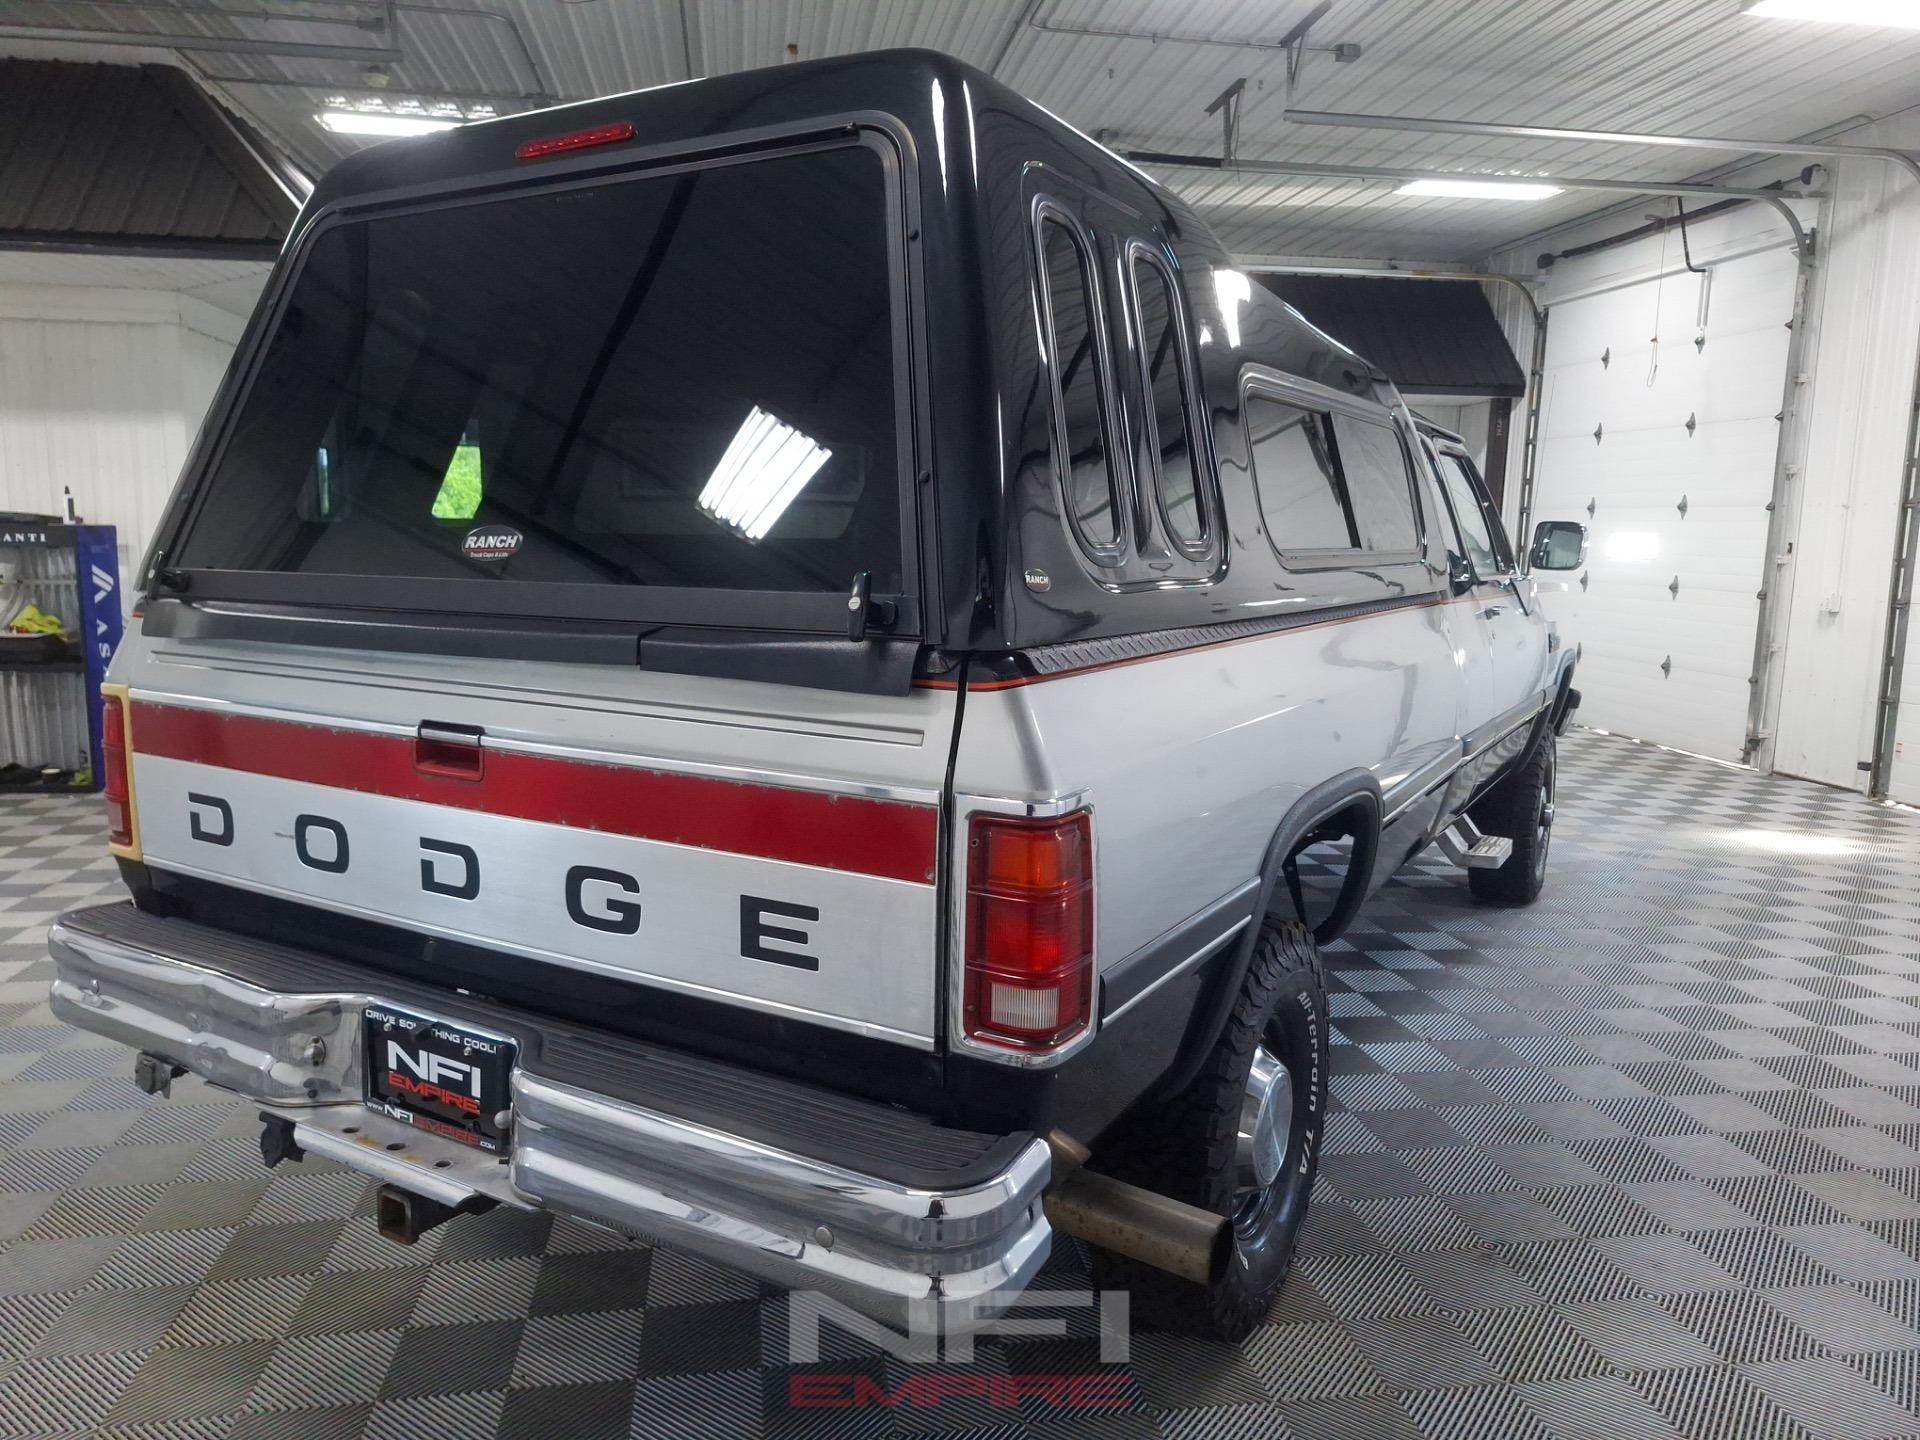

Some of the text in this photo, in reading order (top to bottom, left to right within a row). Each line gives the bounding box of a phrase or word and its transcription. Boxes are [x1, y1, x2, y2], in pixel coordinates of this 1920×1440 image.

[3, 533, 47, 543] ANTI
[465, 535, 518, 549] RANCH
[1025, 574, 1049, 585] RANCH
[188, 791, 820, 972] DODGE
[365, 1009, 396, 1026] DRIVE
[387, 1039, 481, 1099] NFI
[1297, 991, 1320, 1175] All-Terrain T/A
[388, 1071, 481, 1116] EMPIRE
